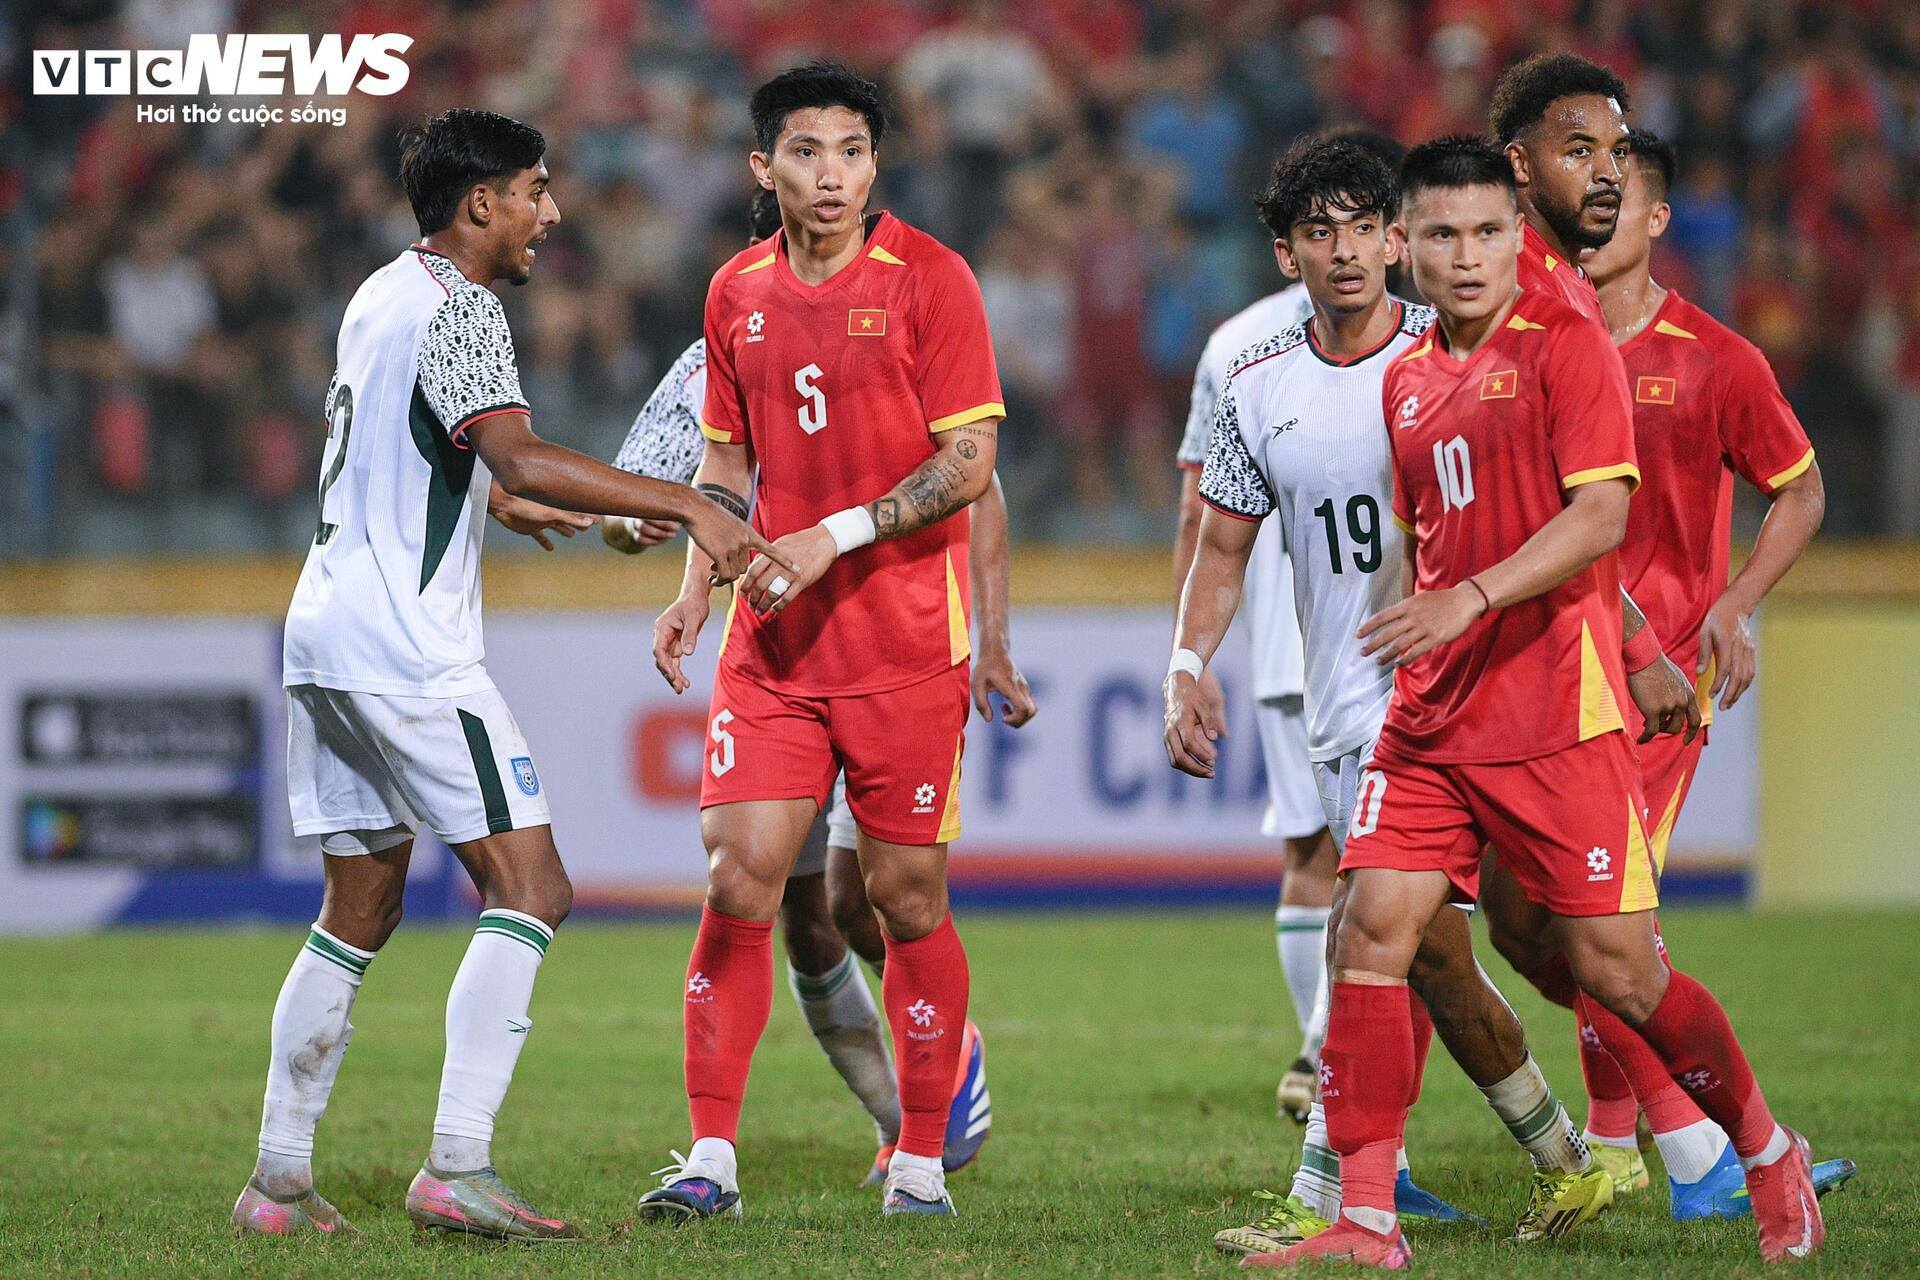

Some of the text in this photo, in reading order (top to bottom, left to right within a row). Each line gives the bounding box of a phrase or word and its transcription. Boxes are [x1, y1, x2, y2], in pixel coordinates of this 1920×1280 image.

[795, 362, 827, 436] 5
[1432, 434, 1475, 515] 10
[1314, 494, 1382, 575] 19
[711, 708, 735, 778] 5
[1351, 769, 1388, 839] 0
